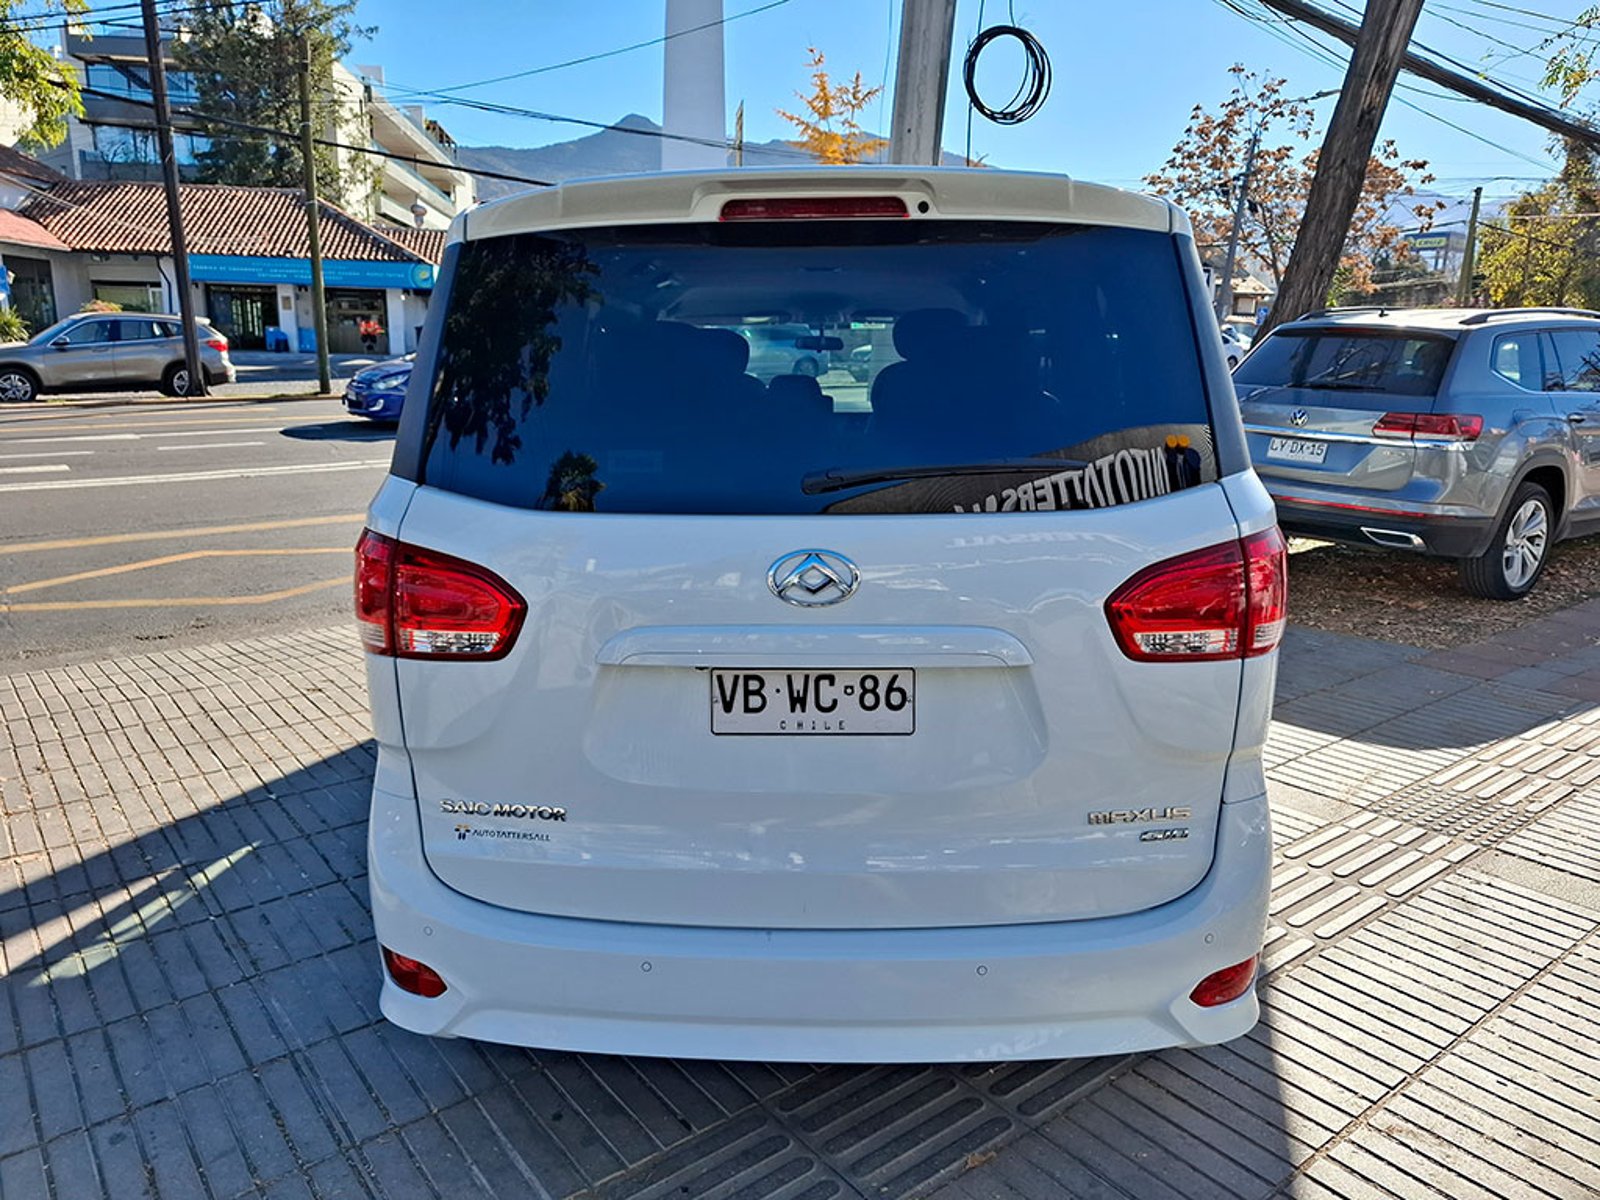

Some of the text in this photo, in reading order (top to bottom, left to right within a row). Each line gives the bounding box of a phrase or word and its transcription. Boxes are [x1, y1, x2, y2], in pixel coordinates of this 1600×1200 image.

[779, 720, 846, 730] CHILE
[440, 799, 567, 821] SAIC MOTOR
[1087, 805, 1192, 825] MAXUS
[472, 829, 551, 841] AUTOTATTERSALL
